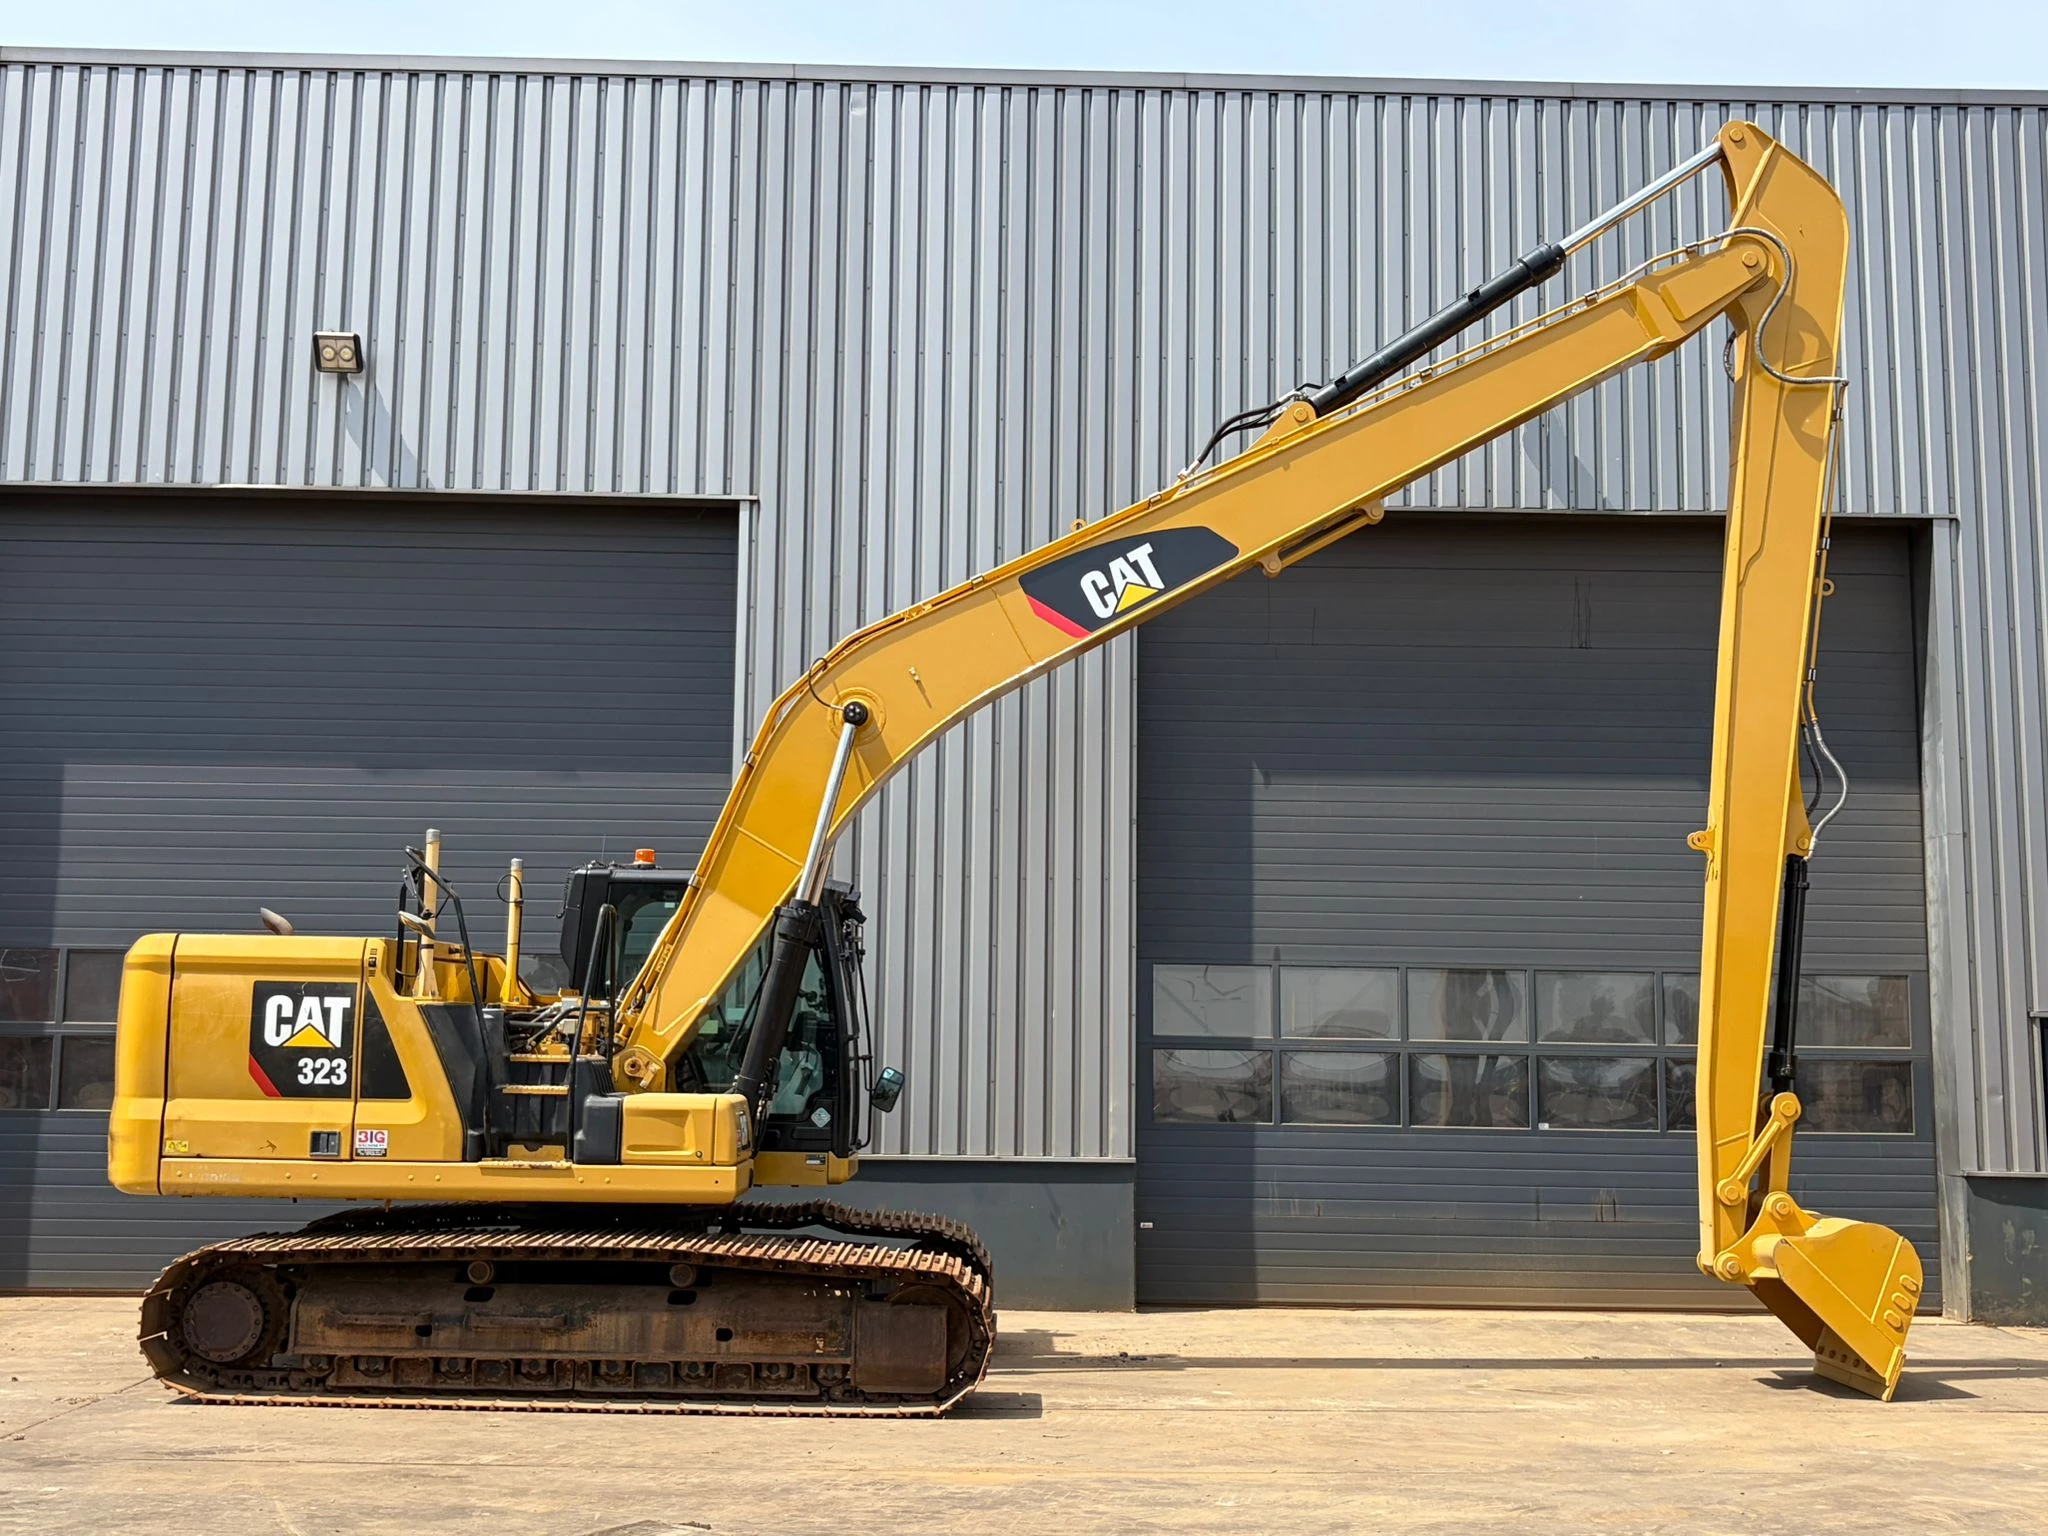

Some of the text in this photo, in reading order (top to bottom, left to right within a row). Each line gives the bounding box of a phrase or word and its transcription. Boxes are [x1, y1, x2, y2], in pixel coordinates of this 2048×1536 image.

[1080, 542, 1165, 619] CAT
[264, 994, 351, 1048] CAT
[297, 1057, 347, 1085] 323
